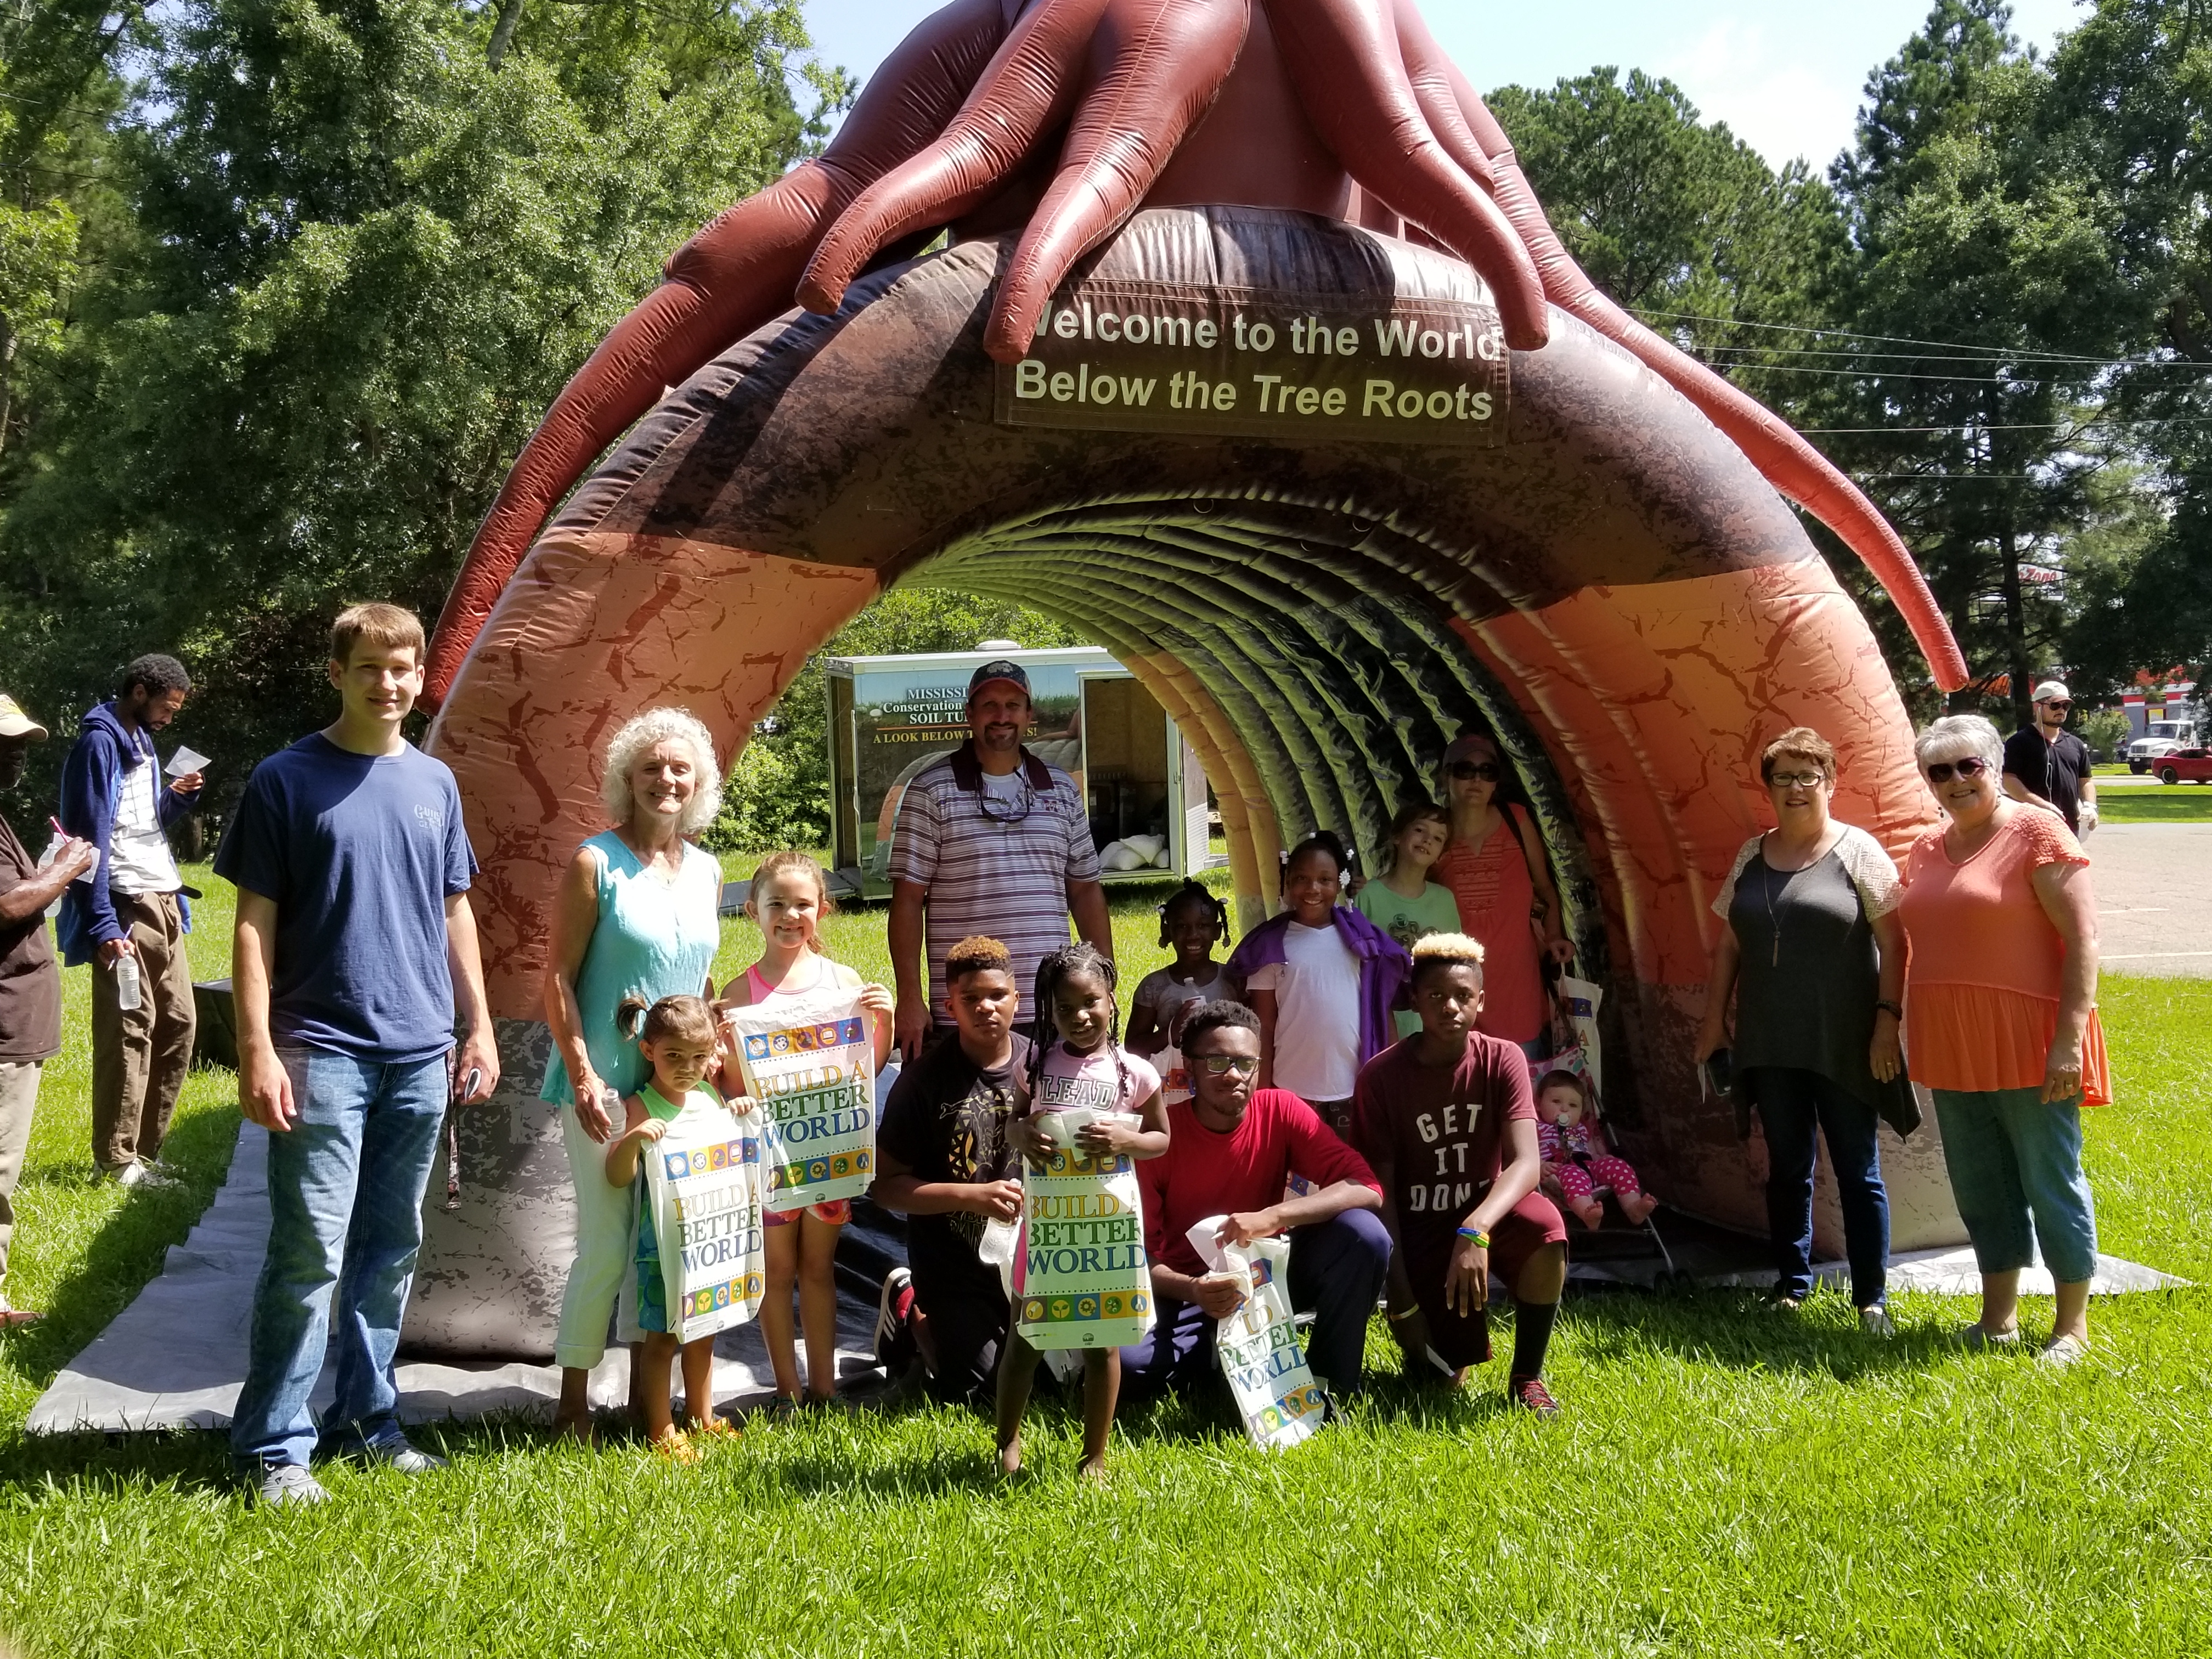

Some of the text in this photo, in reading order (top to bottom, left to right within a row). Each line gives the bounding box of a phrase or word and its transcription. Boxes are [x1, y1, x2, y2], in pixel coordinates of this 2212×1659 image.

[1233, 309, 1275, 352] to
[1290, 317, 1359, 357] the
[1374, 319, 1501, 362] World
[1016, 359, 1493, 421] Below the Tree Roots
[883, 700, 962, 713] Conservation
[908, 687, 968, 699] MISSISSI
[873, 734, 881, 743] A
[884, 732, 918, 743] LOOK
[922, 730, 964, 741] BELOW
[909, 713, 943, 724] SOIL
[752, 1059, 867, 1099] BUILD A
[1041, 1076, 1116, 1110] LEAD
[759, 1084, 870, 1124] BETTER
[763, 1108, 870, 1149] WORLD
[1416, 1104, 1482, 1143] GET
[1435, 1143, 1469, 1176] IT
[673, 1180, 760, 1221] BUILD A
[1030, 1194, 1119, 1220] BUILD
[1410, 1178, 1489, 1211] DON
[678, 1204, 761, 1247] BETTER
[681, 1229, 762, 1274] WORLD
[1028, 1244, 1147, 1276] WORLD
